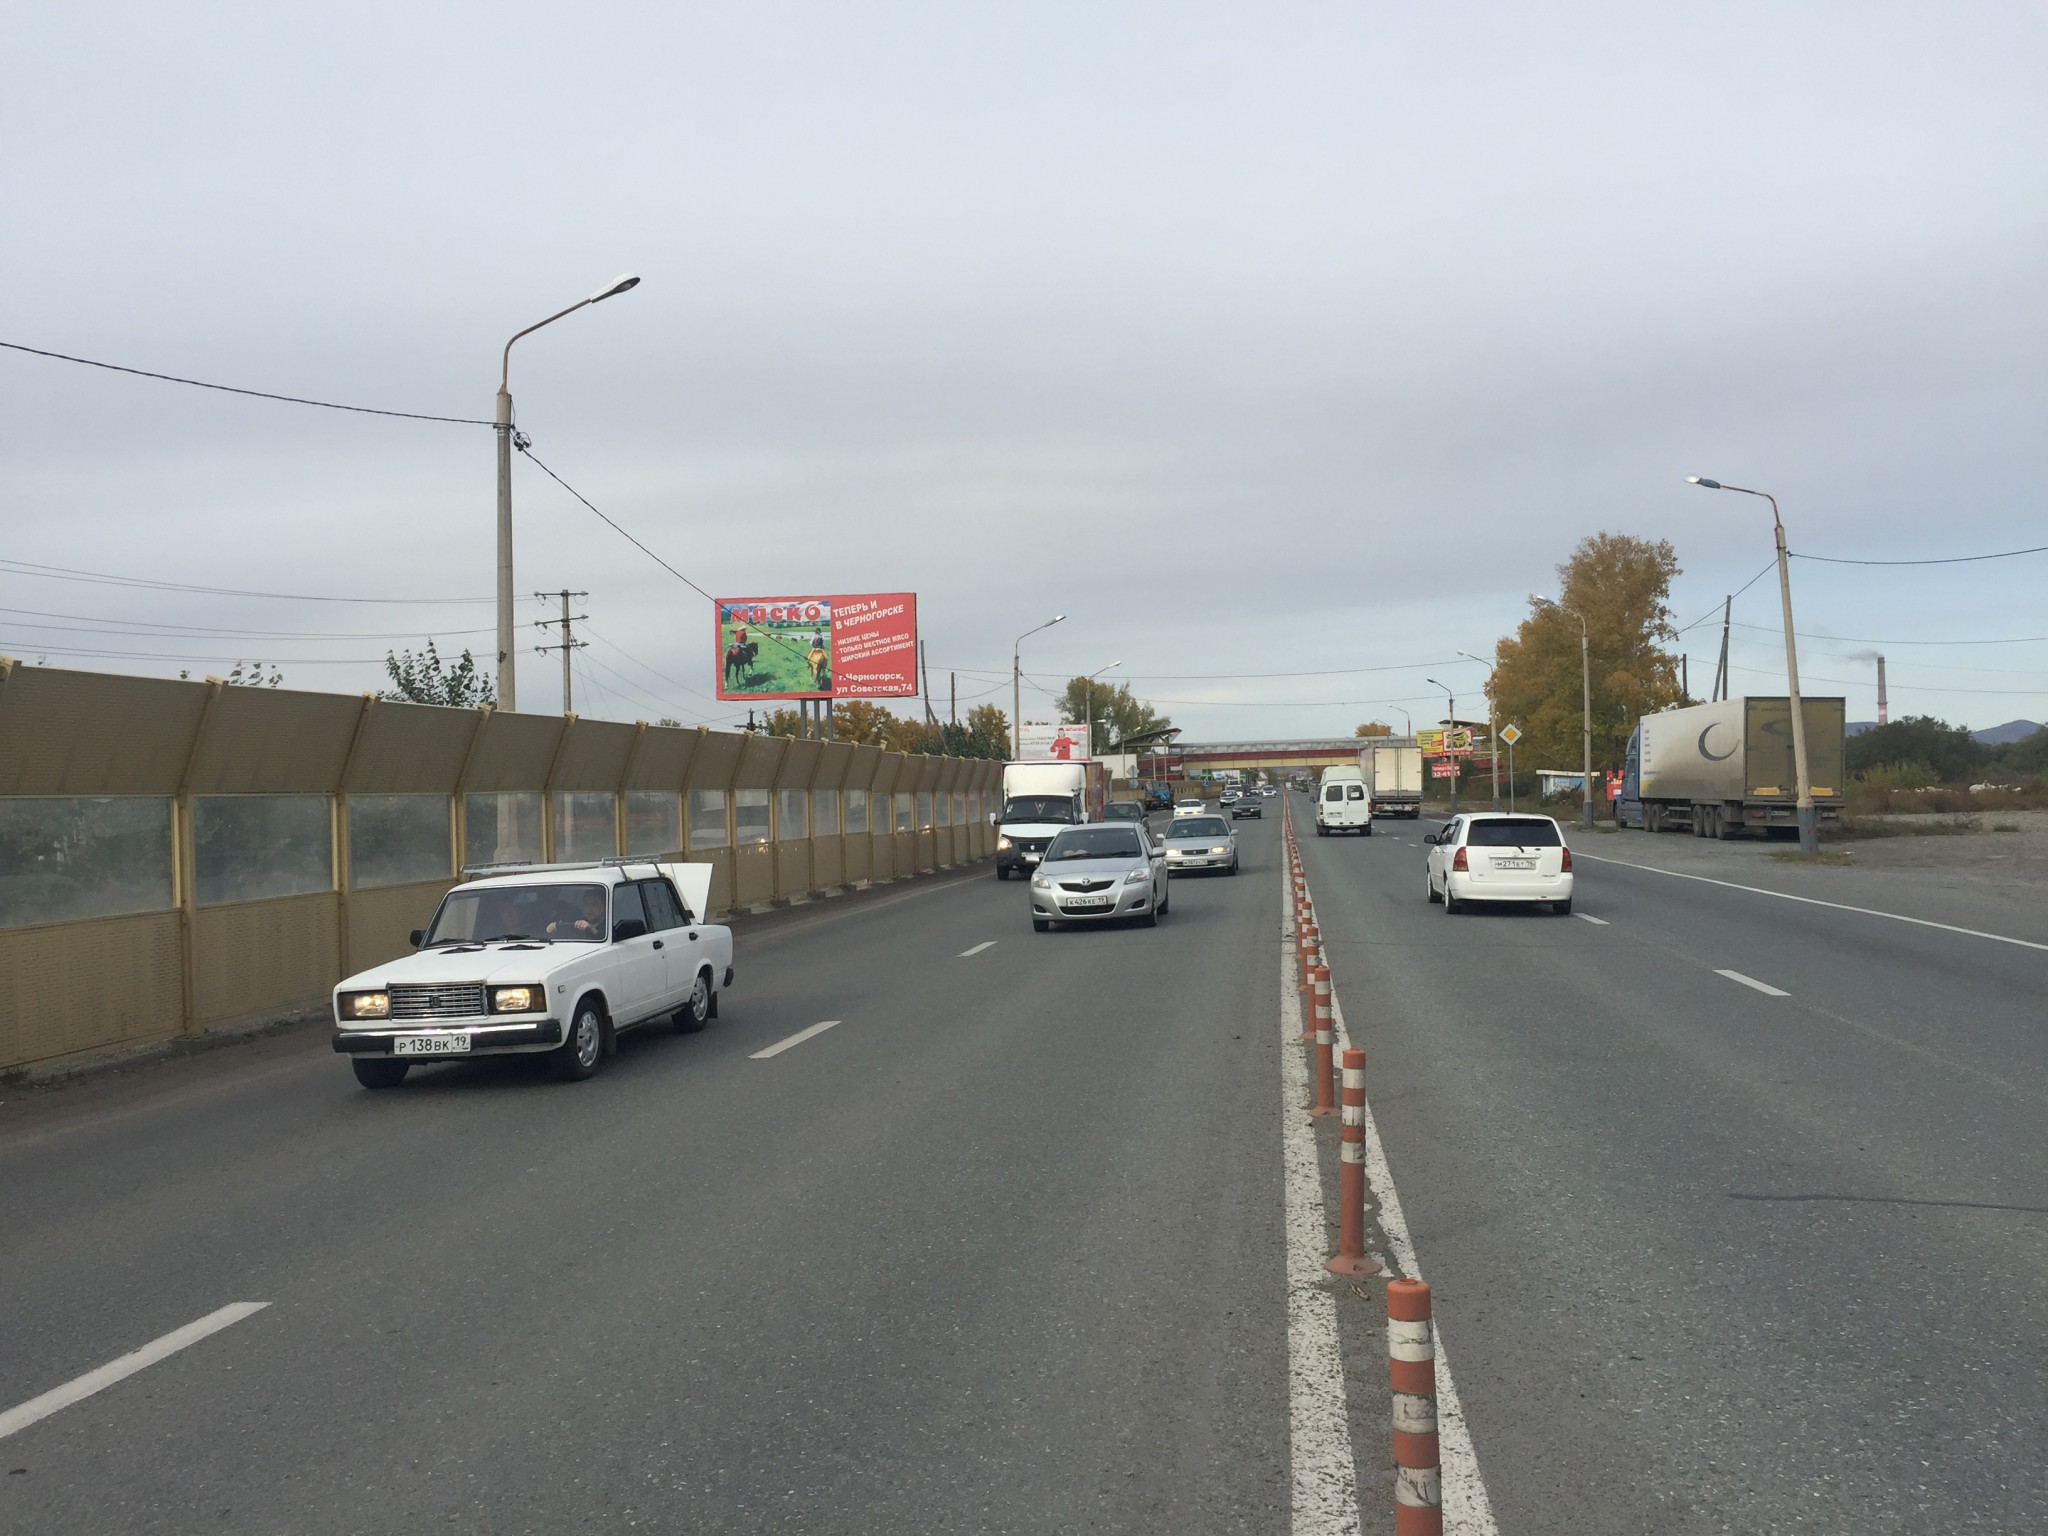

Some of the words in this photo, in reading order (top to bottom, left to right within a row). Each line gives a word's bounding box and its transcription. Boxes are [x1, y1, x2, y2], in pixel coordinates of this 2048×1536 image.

[731, 604, 821, 622] МЯСКО
[833, 603, 869, 617] ТЕПЕРЬ
[870, 600, 878, 609] И
[835, 621, 843, 630] В
[844, 604, 904, 627] ЧЕРНОГОРСКЕ
[839, 644, 863, 655] ТОЛЬКО
[892, 633, 910, 643] МЯСО
[861, 631, 880, 641] ЦЕНЫ
[871, 641, 914, 656] АССОРТИМЕНТ
[454, 1036, 467, 1047] 19
